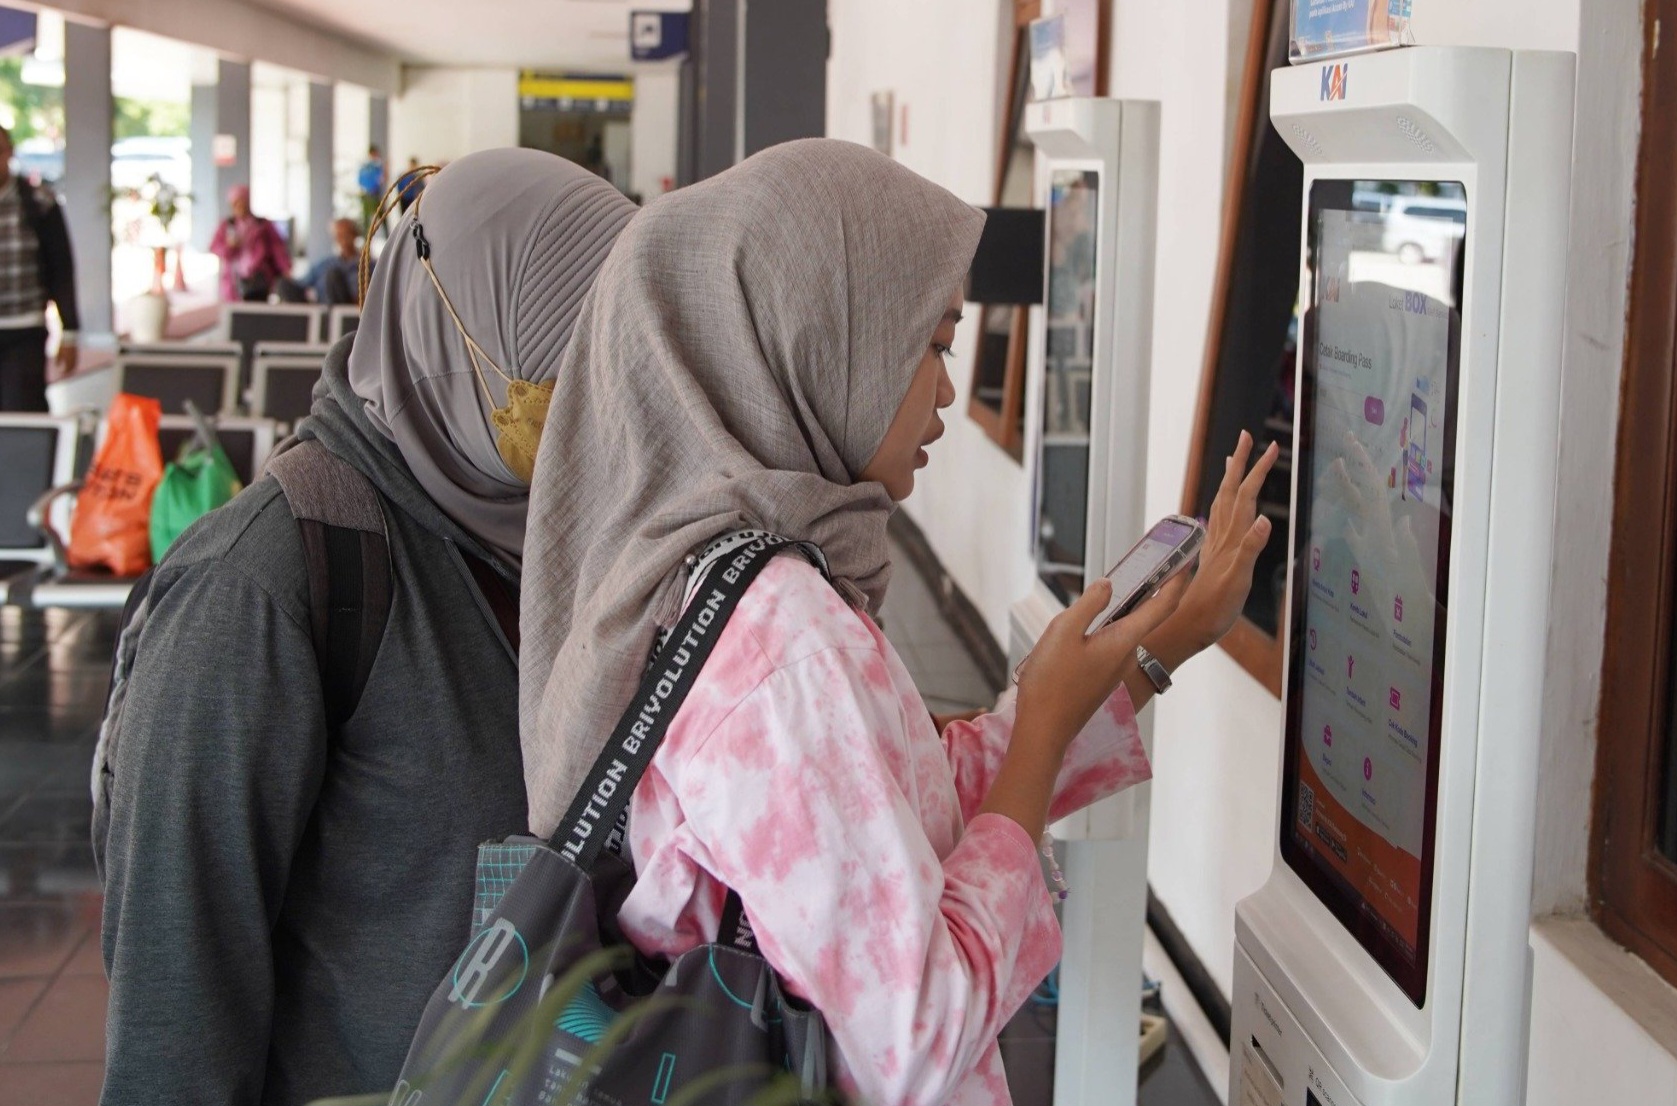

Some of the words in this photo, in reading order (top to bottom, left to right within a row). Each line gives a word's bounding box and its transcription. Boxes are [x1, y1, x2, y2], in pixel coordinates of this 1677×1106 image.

[1320, 63, 1348, 101] KAI
[1404, 290, 1427, 315] BOX
[1334, 346, 1358, 369] Boarding
[1358, 352, 1372, 370] Pass
